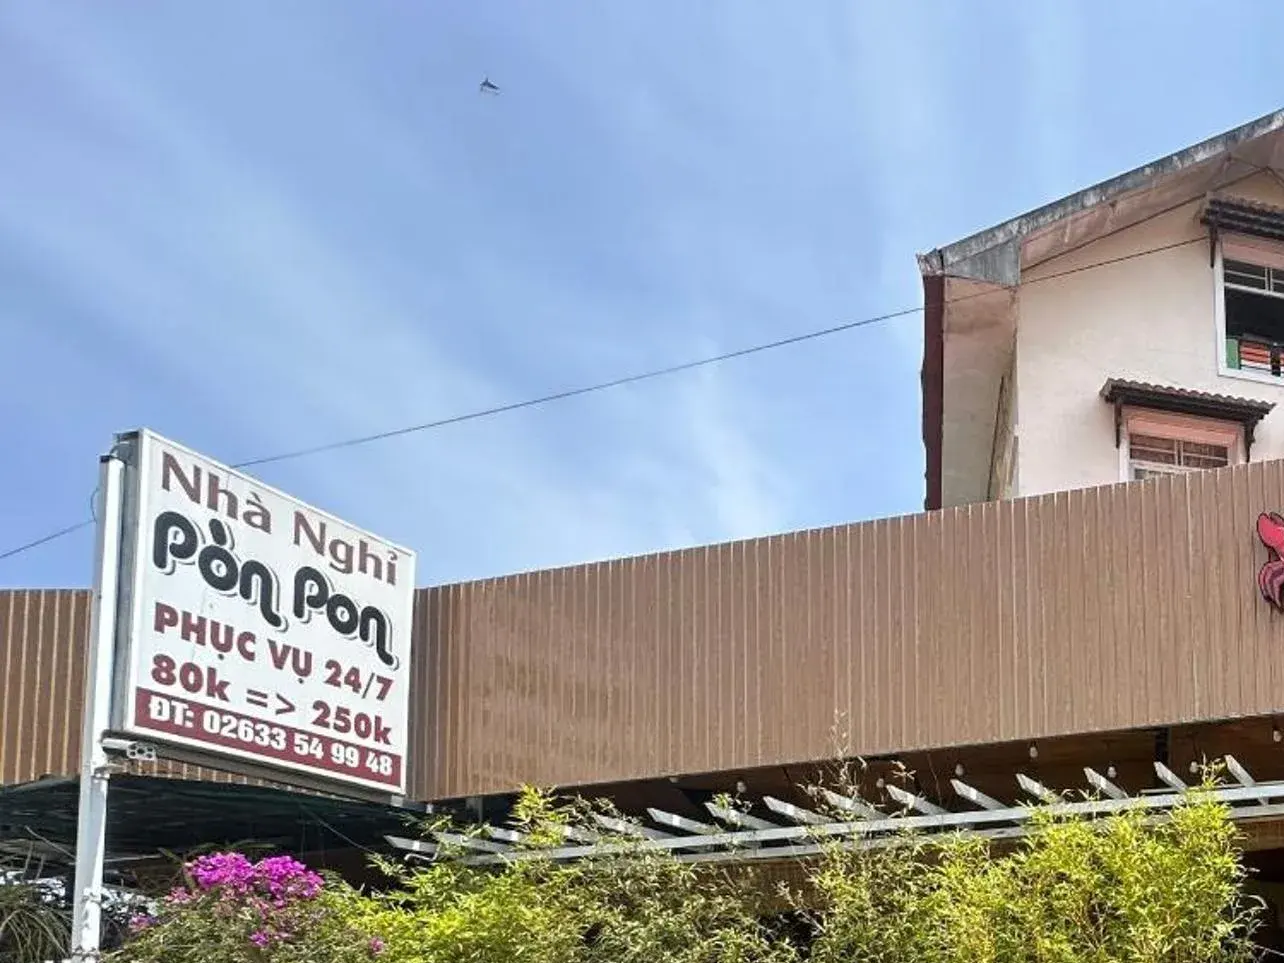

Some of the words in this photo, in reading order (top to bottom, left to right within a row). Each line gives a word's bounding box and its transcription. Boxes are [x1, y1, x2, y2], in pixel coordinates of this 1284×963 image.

[161, 450, 272, 535] Nhà
[293, 510, 398, 586] Nghỉ
[153, 601, 256, 660] PHỤC
[266, 638, 313, 685] VỤ
[324, 658, 395, 701] 24/7
[292, 565, 398, 669] Pon
[149, 695, 194, 728] ĐT:
[203, 709, 287, 751] 02633
[294, 732, 324, 760] 54
[330, 742, 359, 768] 99
[366, 753, 393, 776] 48
[151, 653, 231, 702] 80k
[311, 700, 392, 746] 250k
